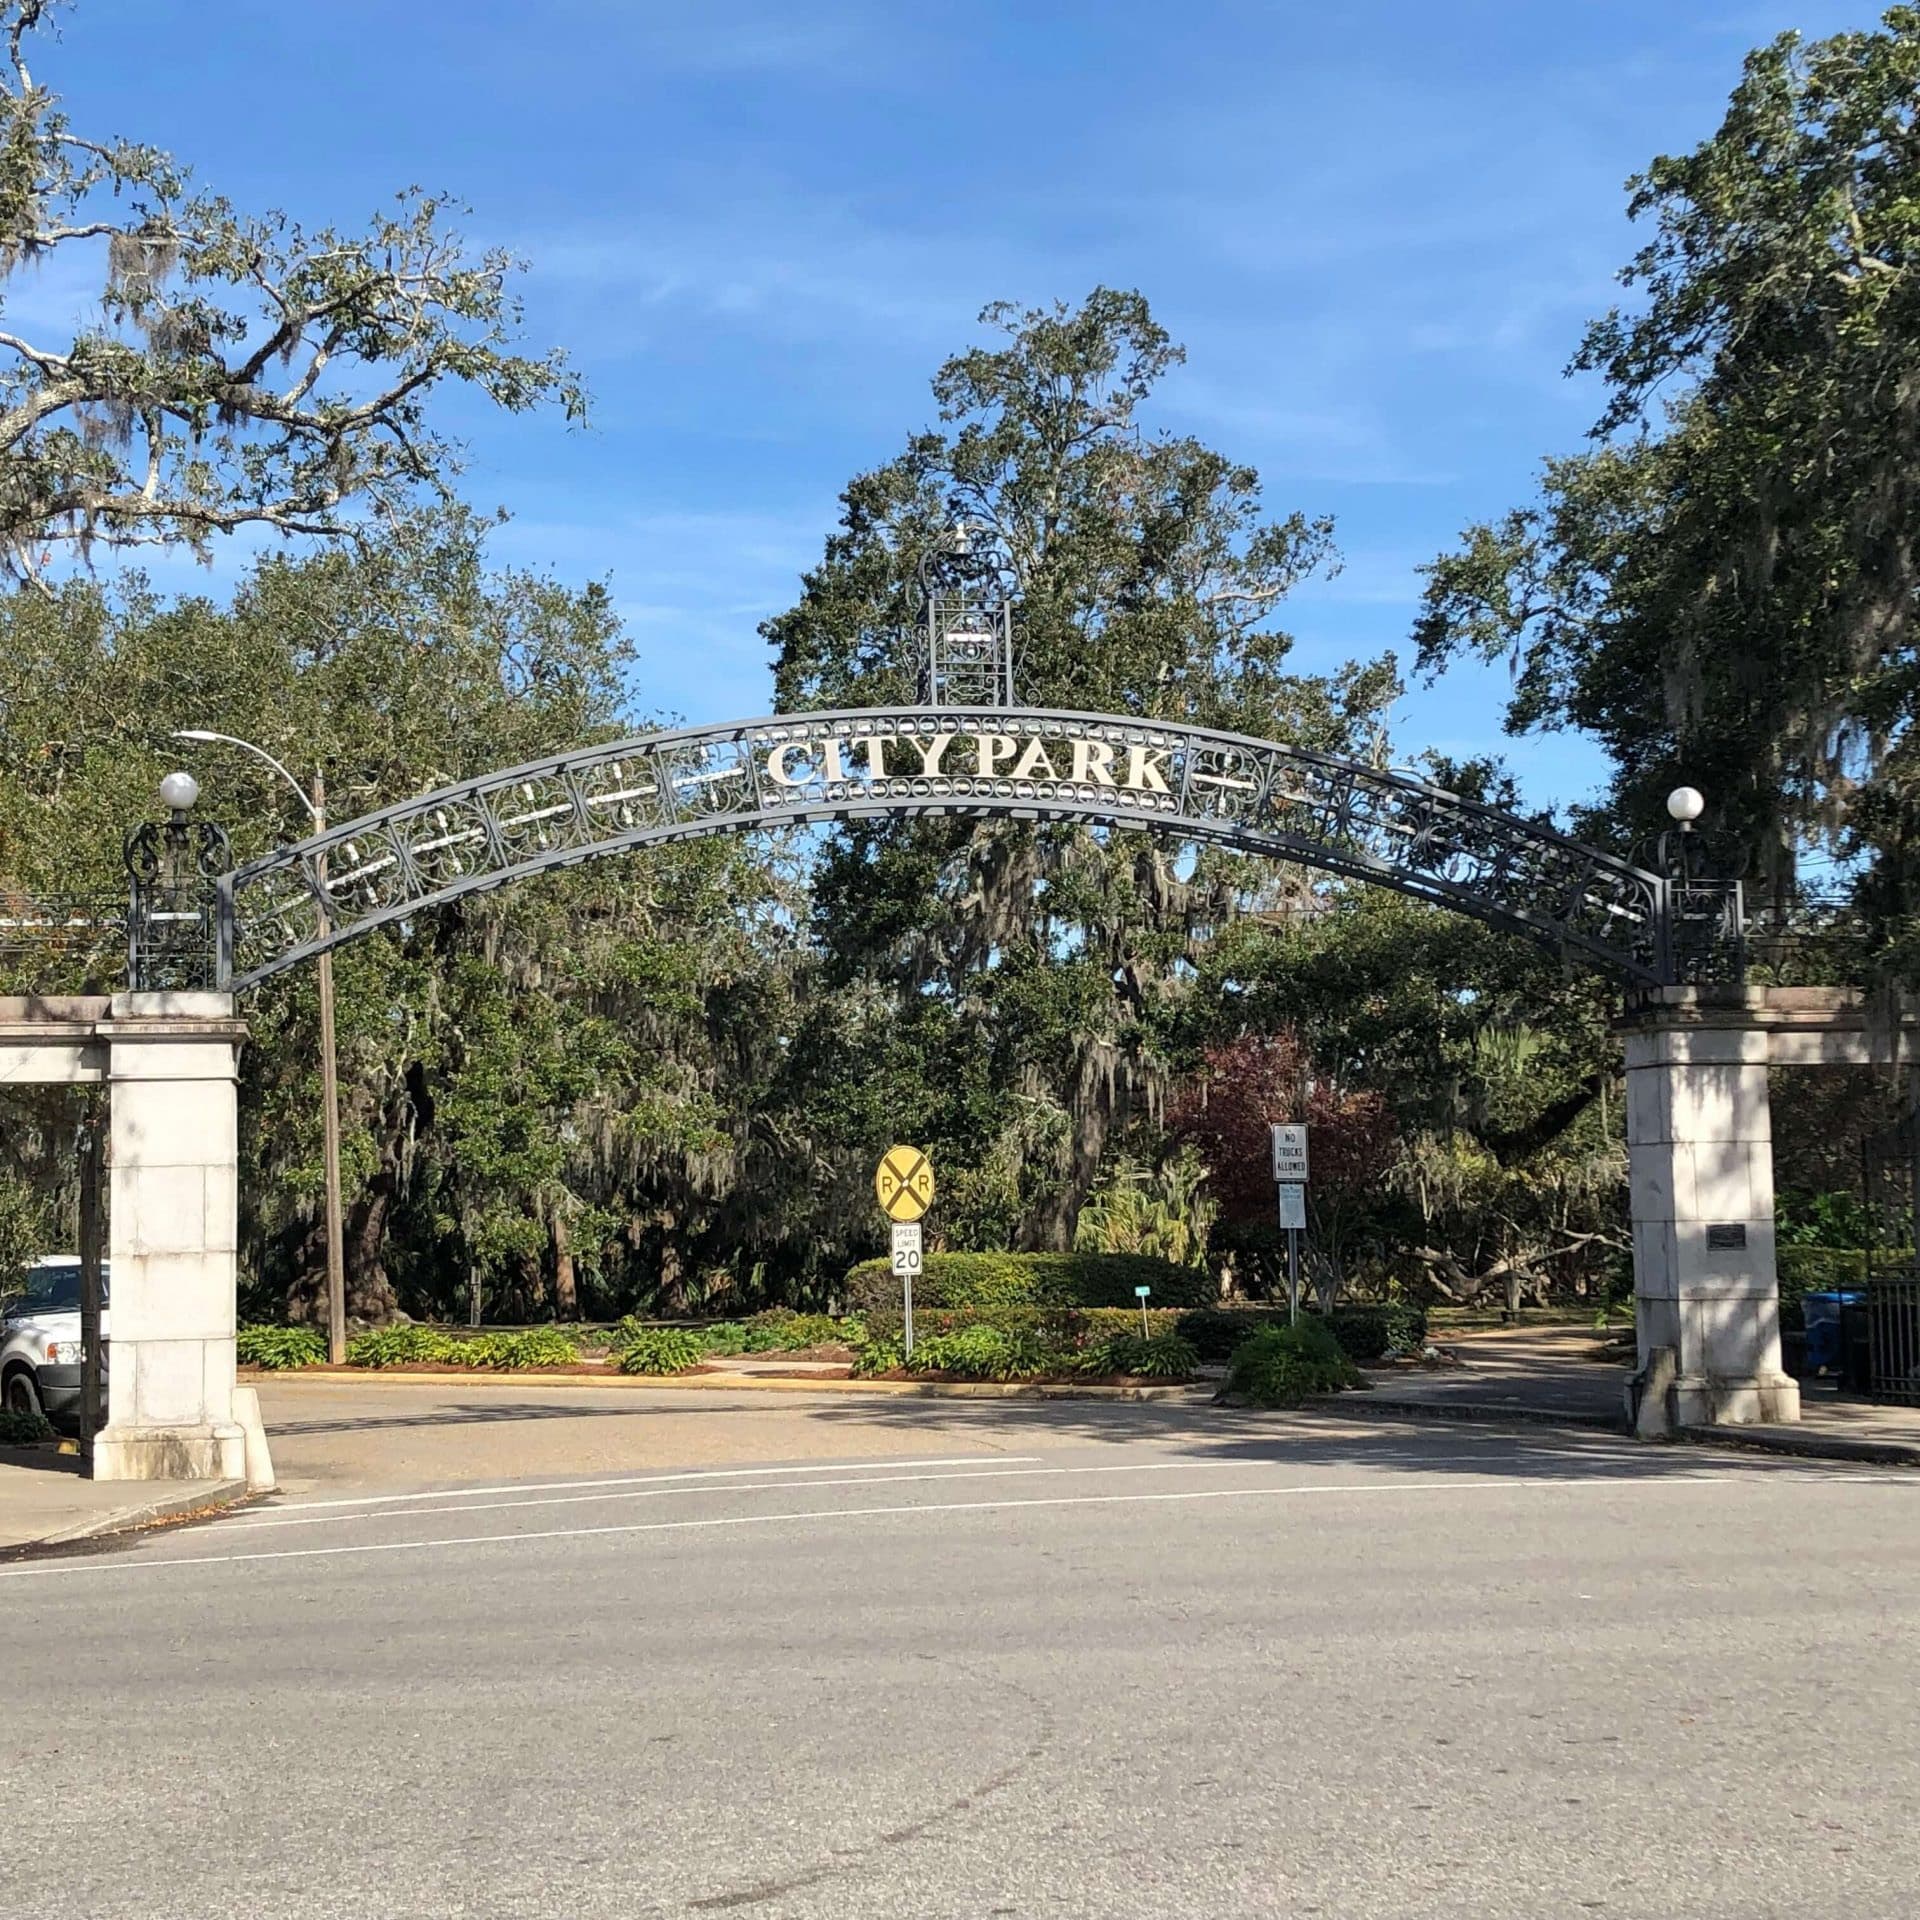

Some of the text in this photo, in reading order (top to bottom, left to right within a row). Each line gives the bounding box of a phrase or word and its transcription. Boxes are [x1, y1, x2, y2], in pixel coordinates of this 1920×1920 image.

[767, 734, 1173, 793] CITY PARK
[1285, 1133, 1296, 1143] NO
[1279, 1147, 1303, 1157] TRUCKS
[1278, 1161, 1305, 1171] ALLOWED
[882, 1175, 929, 1193] R R
[895, 1229, 919, 1237] SPEED
[897, 1239, 916, 1248] LIMIT
[895, 1250, 919, 1269] 20
